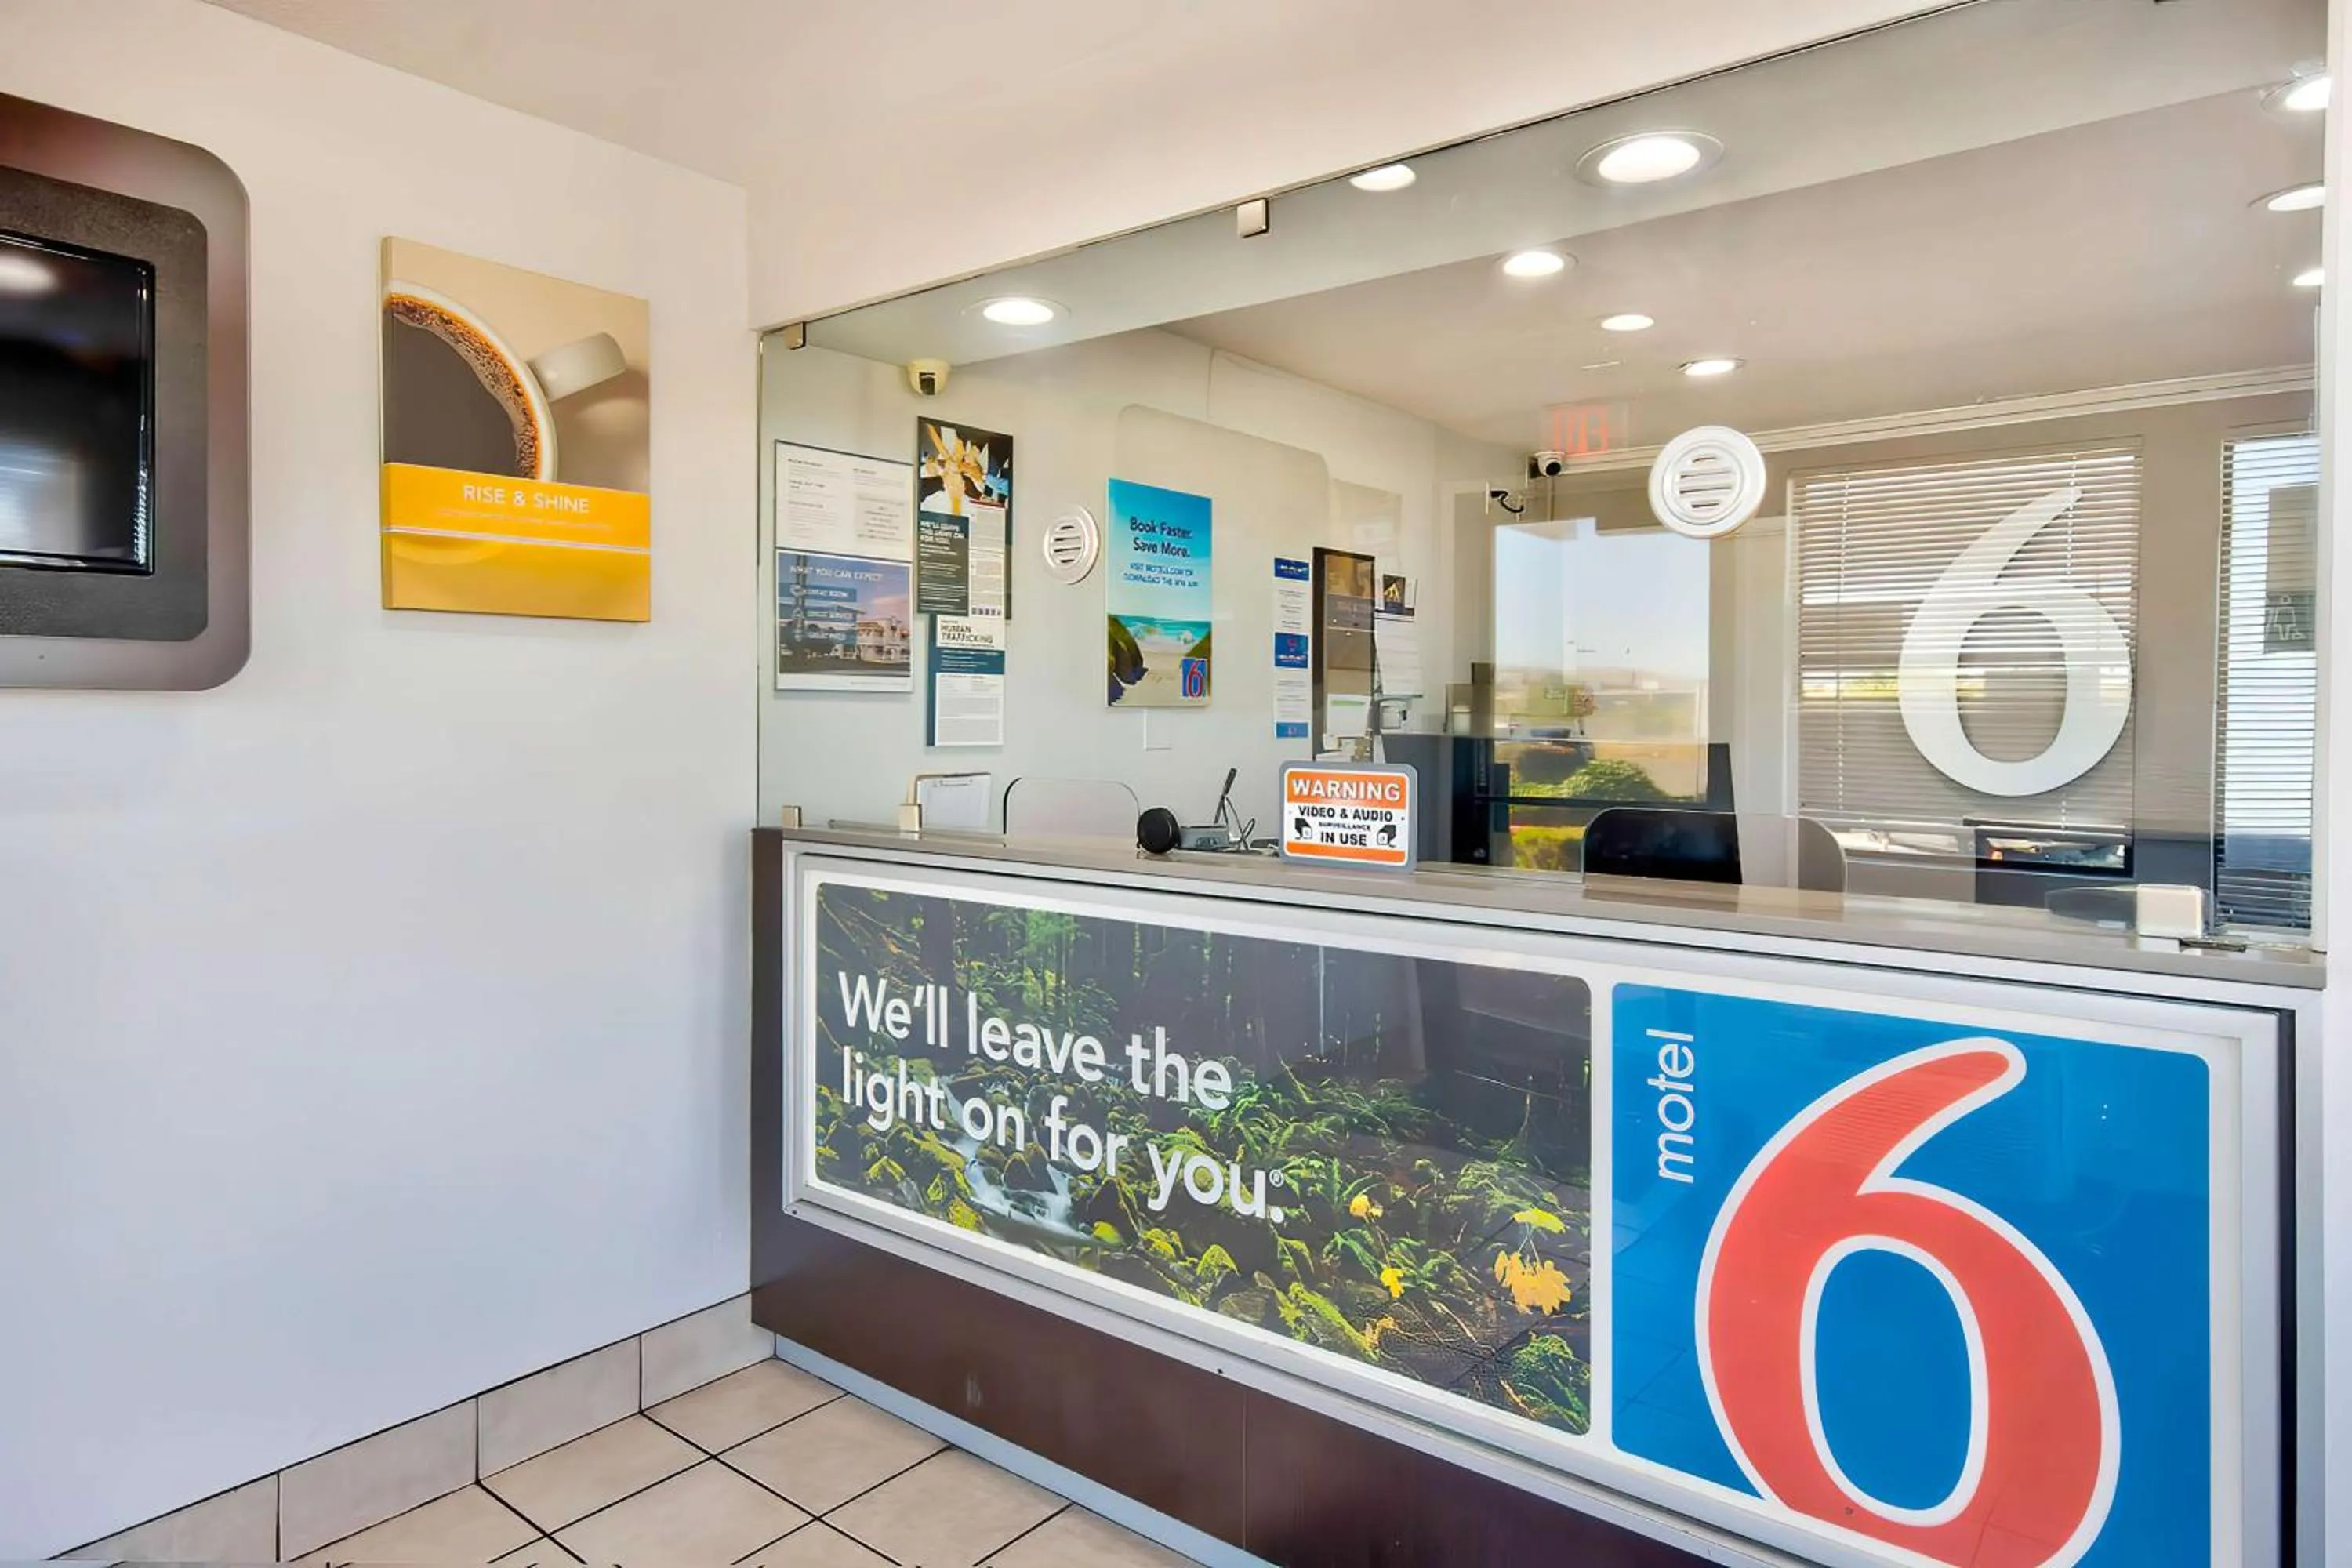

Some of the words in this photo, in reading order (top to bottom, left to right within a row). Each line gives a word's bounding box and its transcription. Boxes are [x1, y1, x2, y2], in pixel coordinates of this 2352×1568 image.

[463, 485, 506, 503] RISE
[514, 490, 526, 506] &
[533, 492, 590, 514] SHINE
[1130, 516, 1157, 533] Book
[1160, 521, 1192, 539] Faster.
[1133, 537, 1157, 554] Save
[1161, 541, 1190, 557] More.
[1898, 485, 2133, 796] 6
[1187, 659, 1204, 699] 6
[1292, 778, 1400, 802] WARNING
[1298, 805, 1335, 818] VIDEO
[1340, 808, 1348, 819] &
[1352, 808, 1393, 822] AUDIO
[1318, 821, 1371, 832] SURVEILLANCE
[1321, 832, 1334, 844] IN
[1340, 833, 1367, 846] USE
[837, 971, 949, 1049] We'll
[967, 990, 1107, 1083] leave
[1124, 1025, 1232, 1111] the
[842, 1044, 946, 1132] light
[960, 1096, 1025, 1152] on
[1044, 1094, 1129, 1178] for
[1647, 1029, 1695, 1183] motel
[1695, 1036, 2122, 1568] 6
